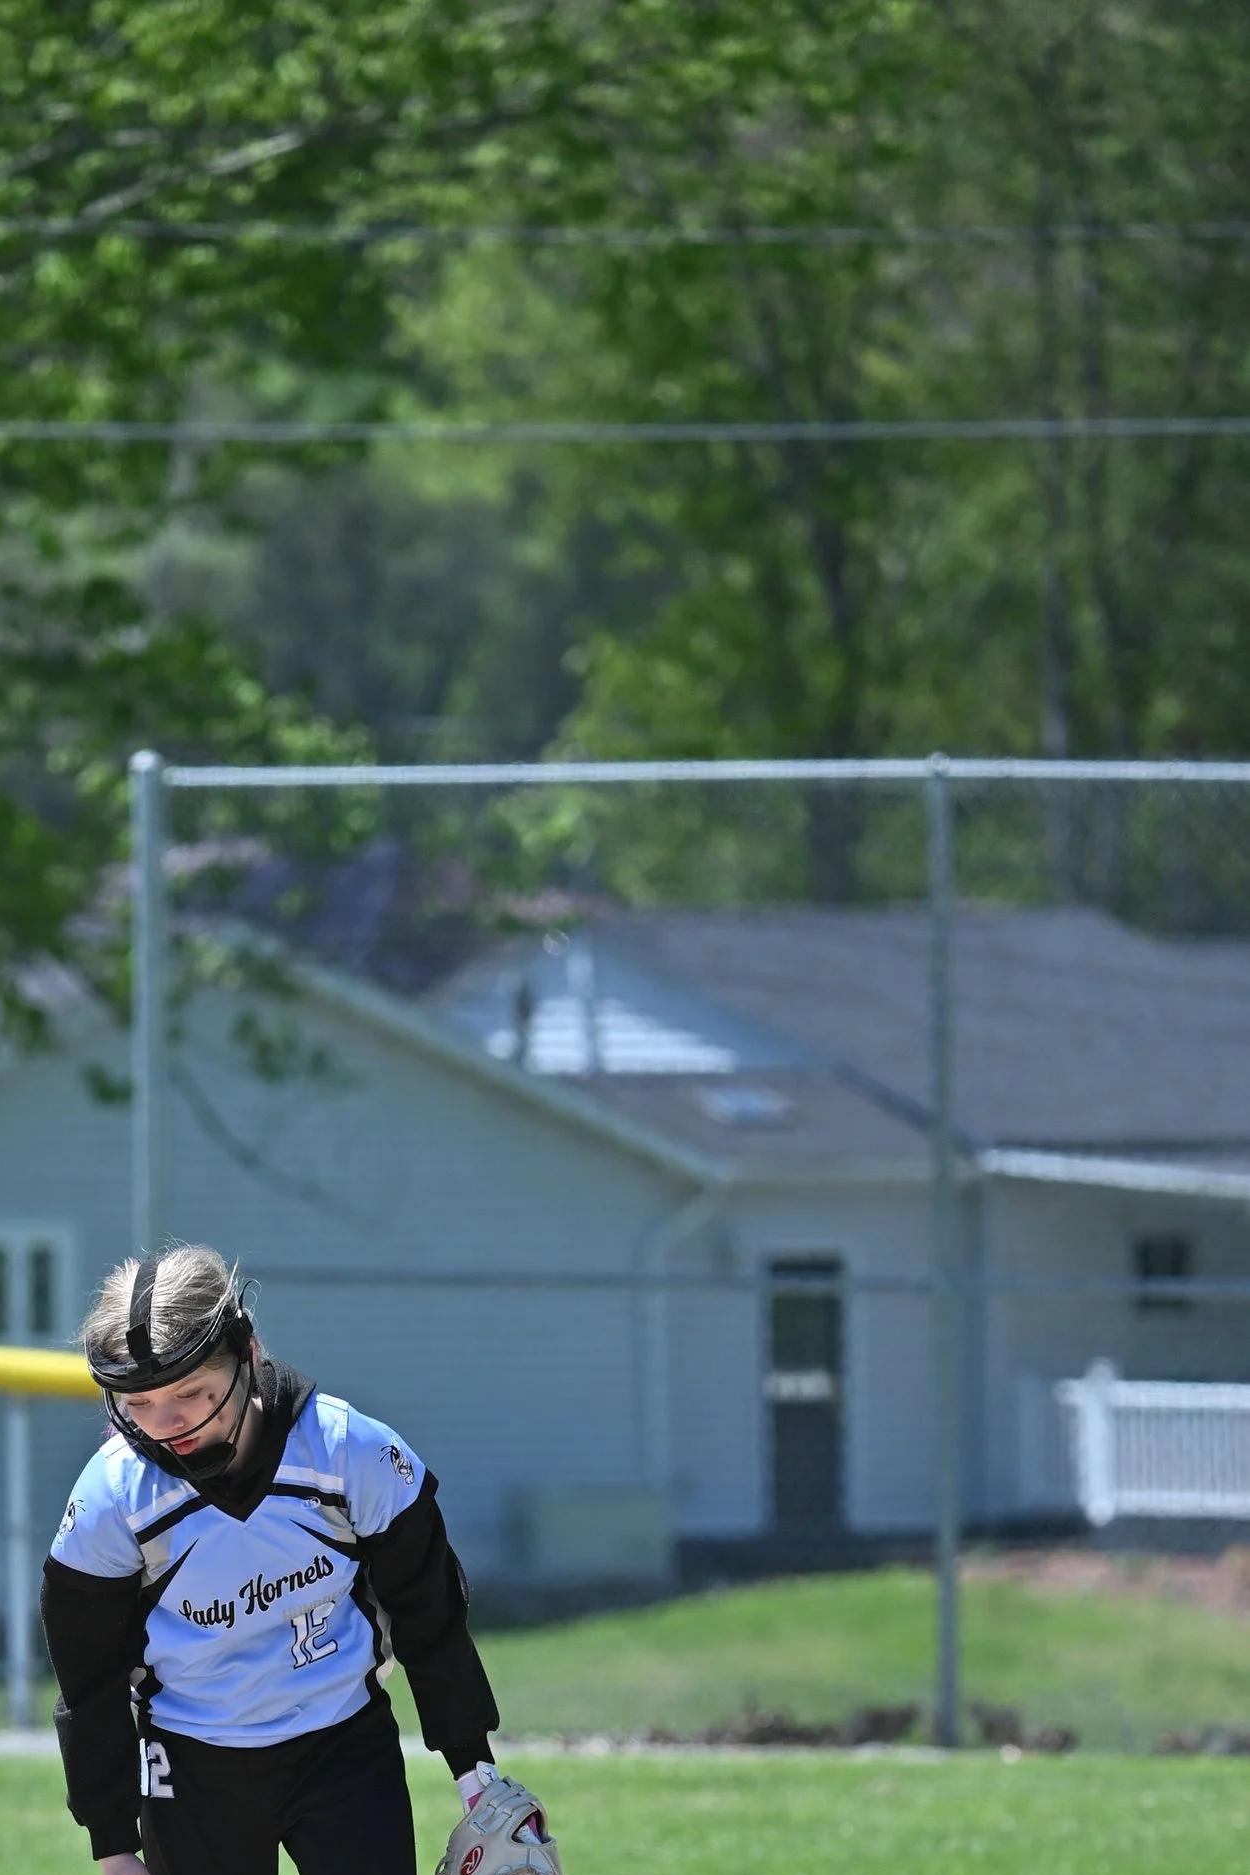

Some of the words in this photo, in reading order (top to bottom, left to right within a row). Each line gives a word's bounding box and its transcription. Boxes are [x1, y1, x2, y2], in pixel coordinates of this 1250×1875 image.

[178, 1598, 235, 1630] Lady
[238, 1554, 335, 1616] Hornets
[290, 1600, 339, 1670] 12
